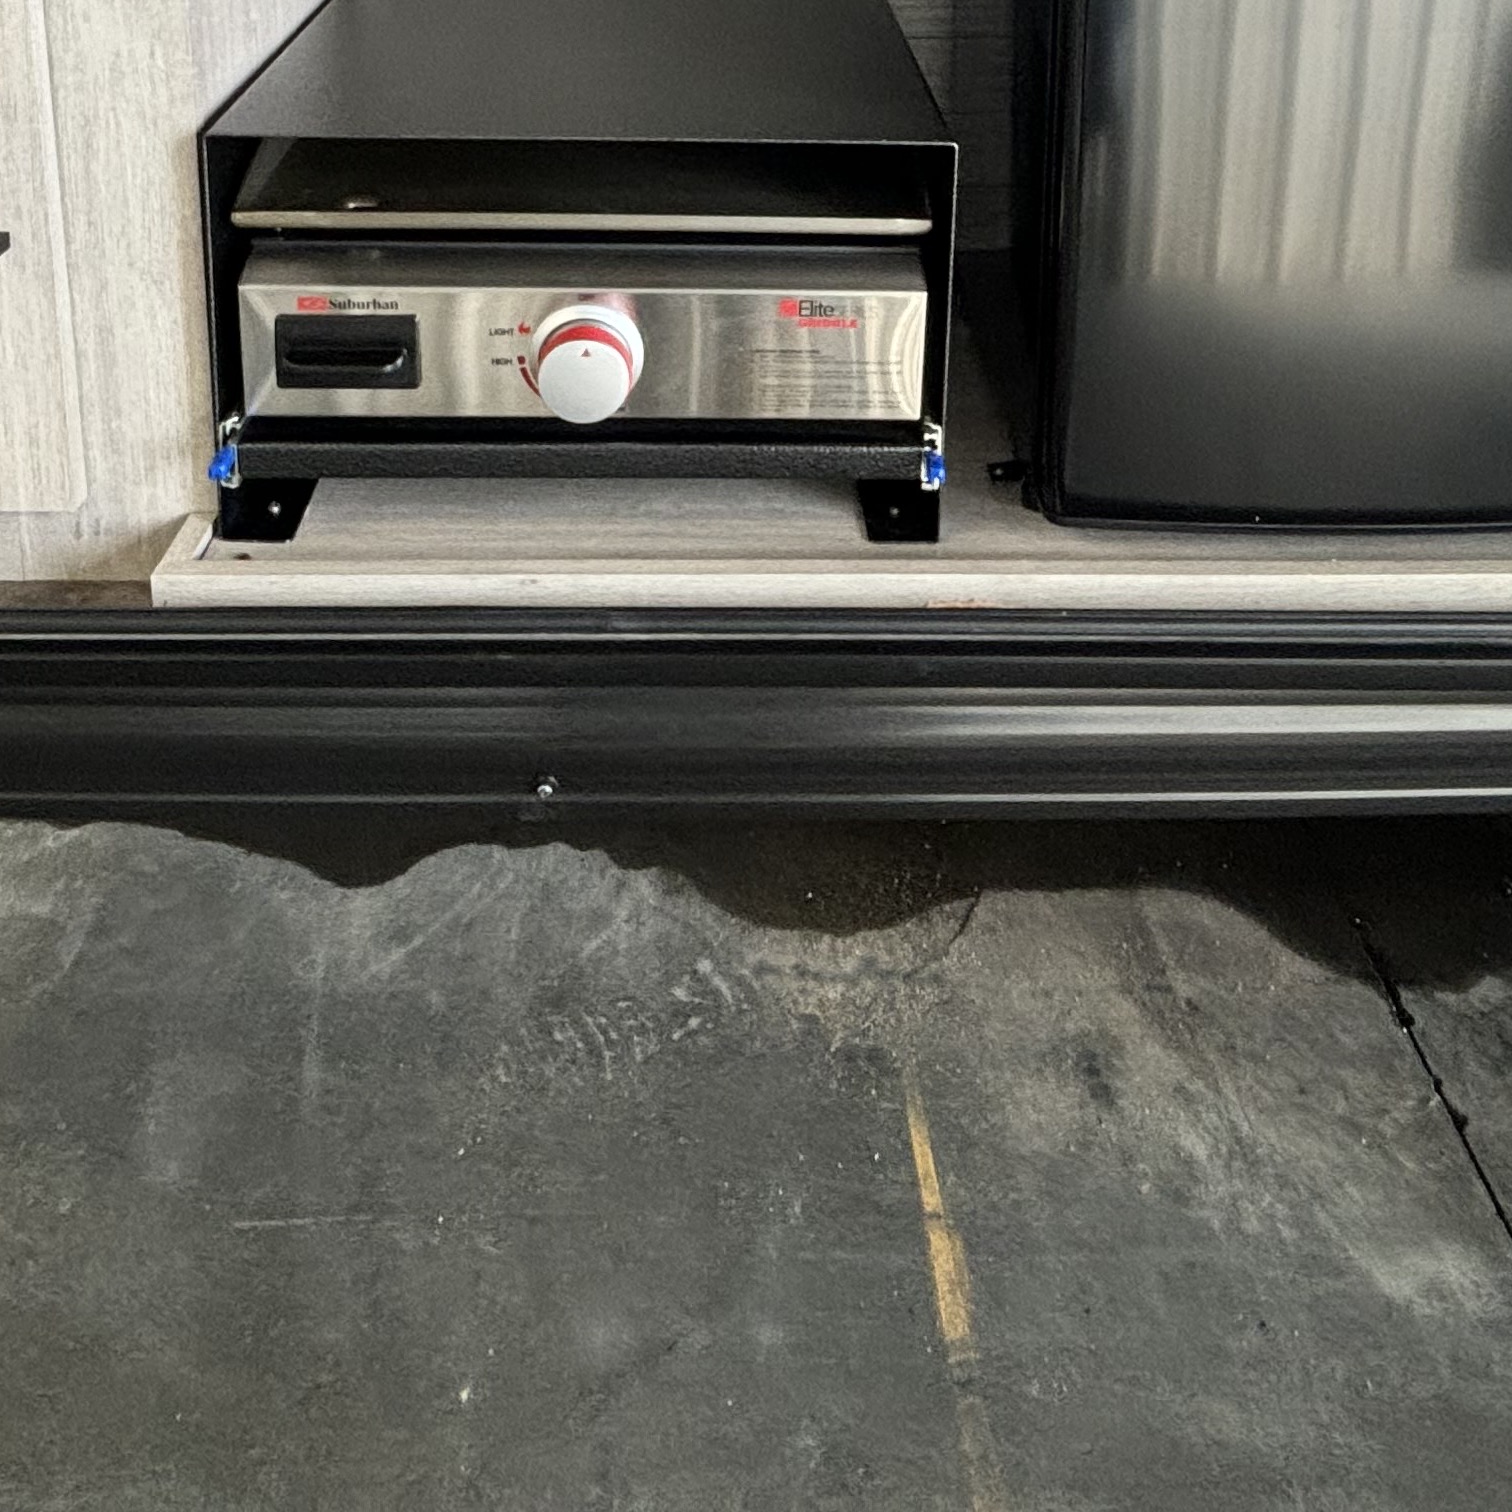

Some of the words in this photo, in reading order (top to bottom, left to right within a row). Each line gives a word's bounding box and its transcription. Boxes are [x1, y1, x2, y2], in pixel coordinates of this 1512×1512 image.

[329, 298, 399, 311] Suburban
[798, 299, 835, 318] Elite
[489, 328, 514, 337] LIGHT
[491, 358, 513, 366] HIGH
